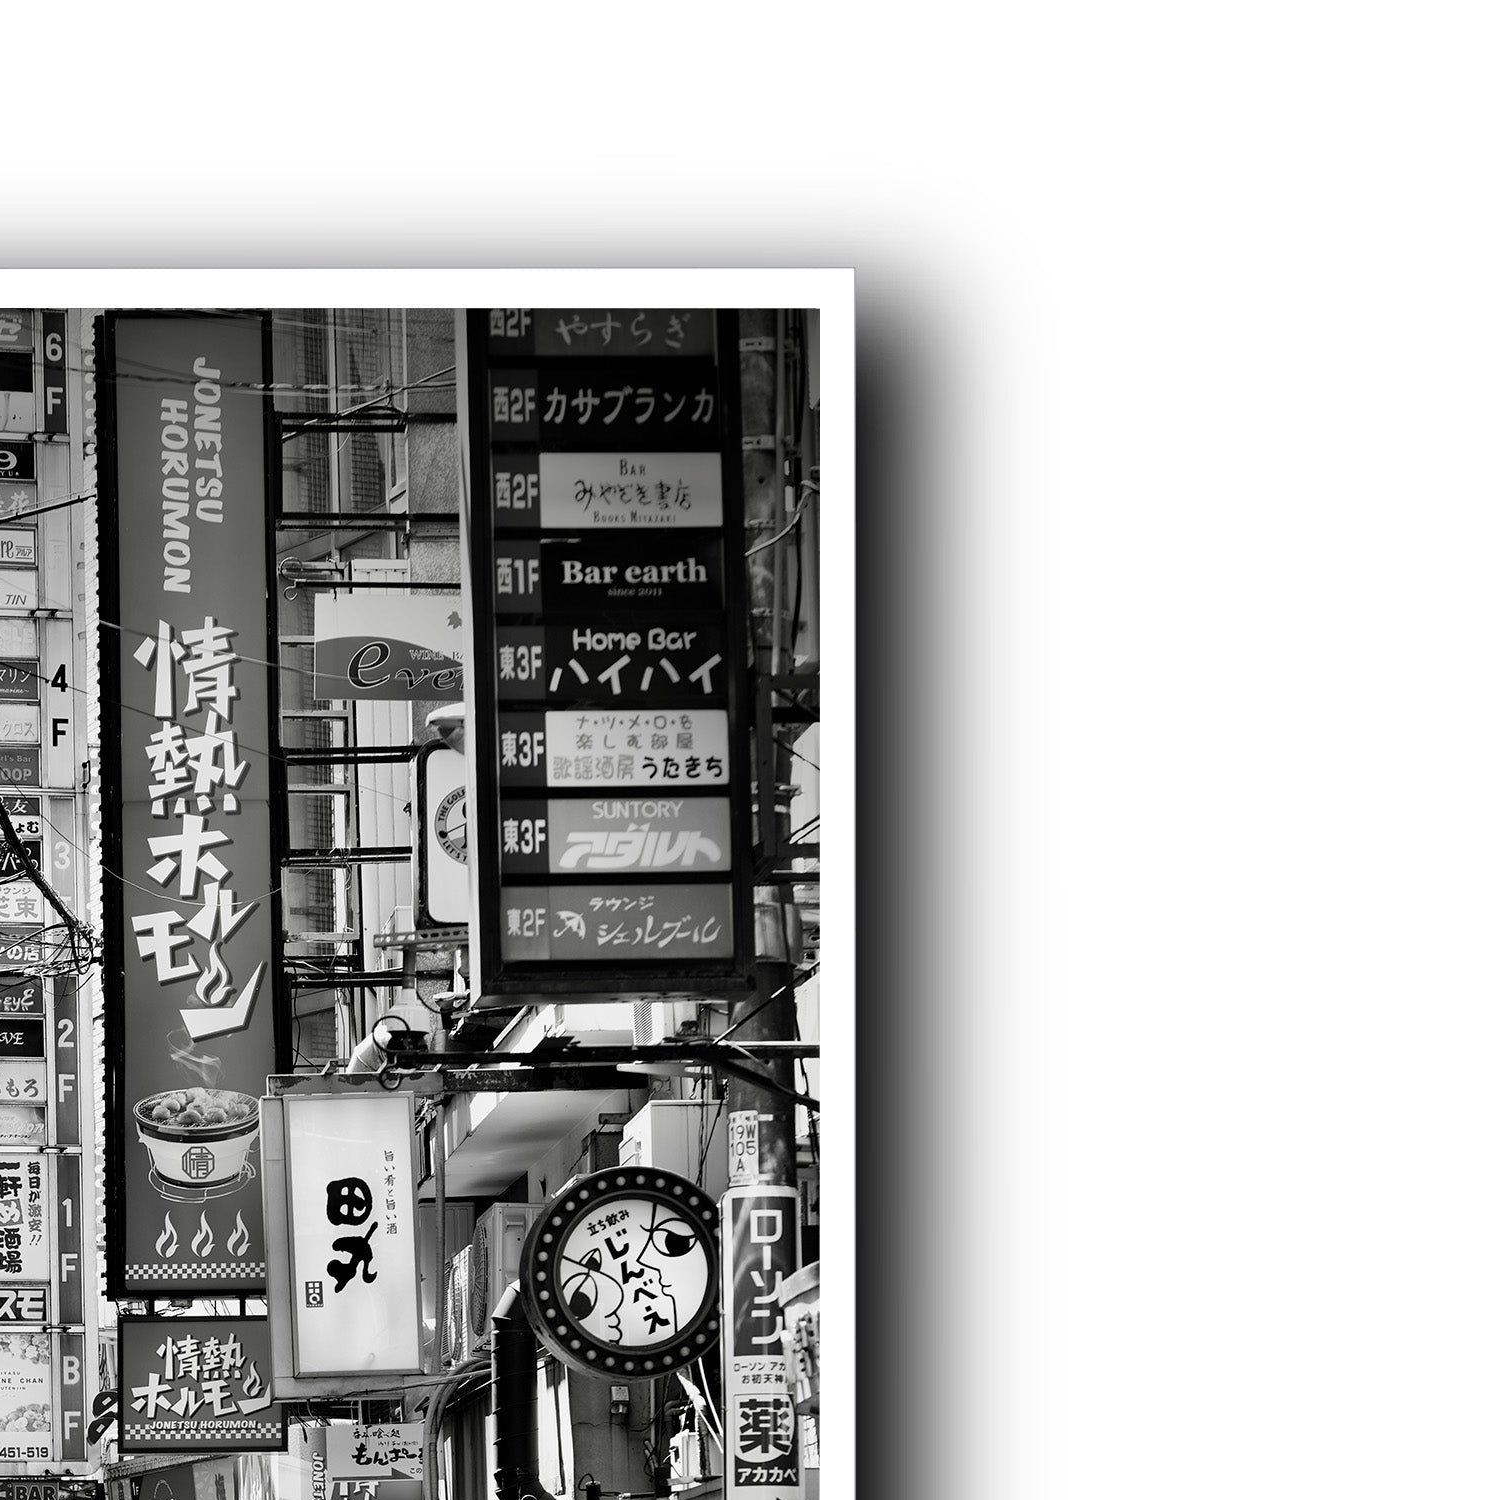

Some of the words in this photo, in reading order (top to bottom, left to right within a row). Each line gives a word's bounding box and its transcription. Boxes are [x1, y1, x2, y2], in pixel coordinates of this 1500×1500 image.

[554, 311, 691, 349] やすらぎ
[543, 385, 714, 425] カサブランカ
[192, 356, 224, 524] JONETSU
[160, 397, 192, 595] HORUMON
[561, 559, 619, 585] Bar
[624, 557, 709, 584] earth
[5, 594, 28, 606] TIN
[607, 586, 637, 597] since
[572, 627, 642, 652] Home
[647, 626, 698, 651] Bar
[499, 644, 543, 681] 東3F
[549, 653, 723, 696] ハイハイ
[501, 730, 545, 768] 東3F
[575, 732, 694, 750] 楽しむ部屋
[641, 754, 724, 780] うたきち
[591, 800, 685, 820] SUNTORY
[502, 817, 547, 855] 東3F
[588, 895, 656, 912] ラウンジ
[506, 907, 547, 938] 東2F
[735, 1157, 746, 1173] A
[586, 1208, 631, 1238] 立ち飲み
[603, 1227, 672, 1337] じんべえ
[749, 1208, 784, 1346] ローソン
[155, 1332, 247, 1382] 情熱
[733, 1362, 767, 1373] ローソン
[19, 1377, 45, 1385] CHAN
[741, 1373, 789, 1385] お初天神
[130, 1372, 272, 1419] ホルモン
[149, 1420, 198, 1431] JONETSU
[200, 1419, 258, 1431] HORUMON
[738, 1397, 791, 1455] 薬
[737, 1466, 799, 1484] アカカベ
